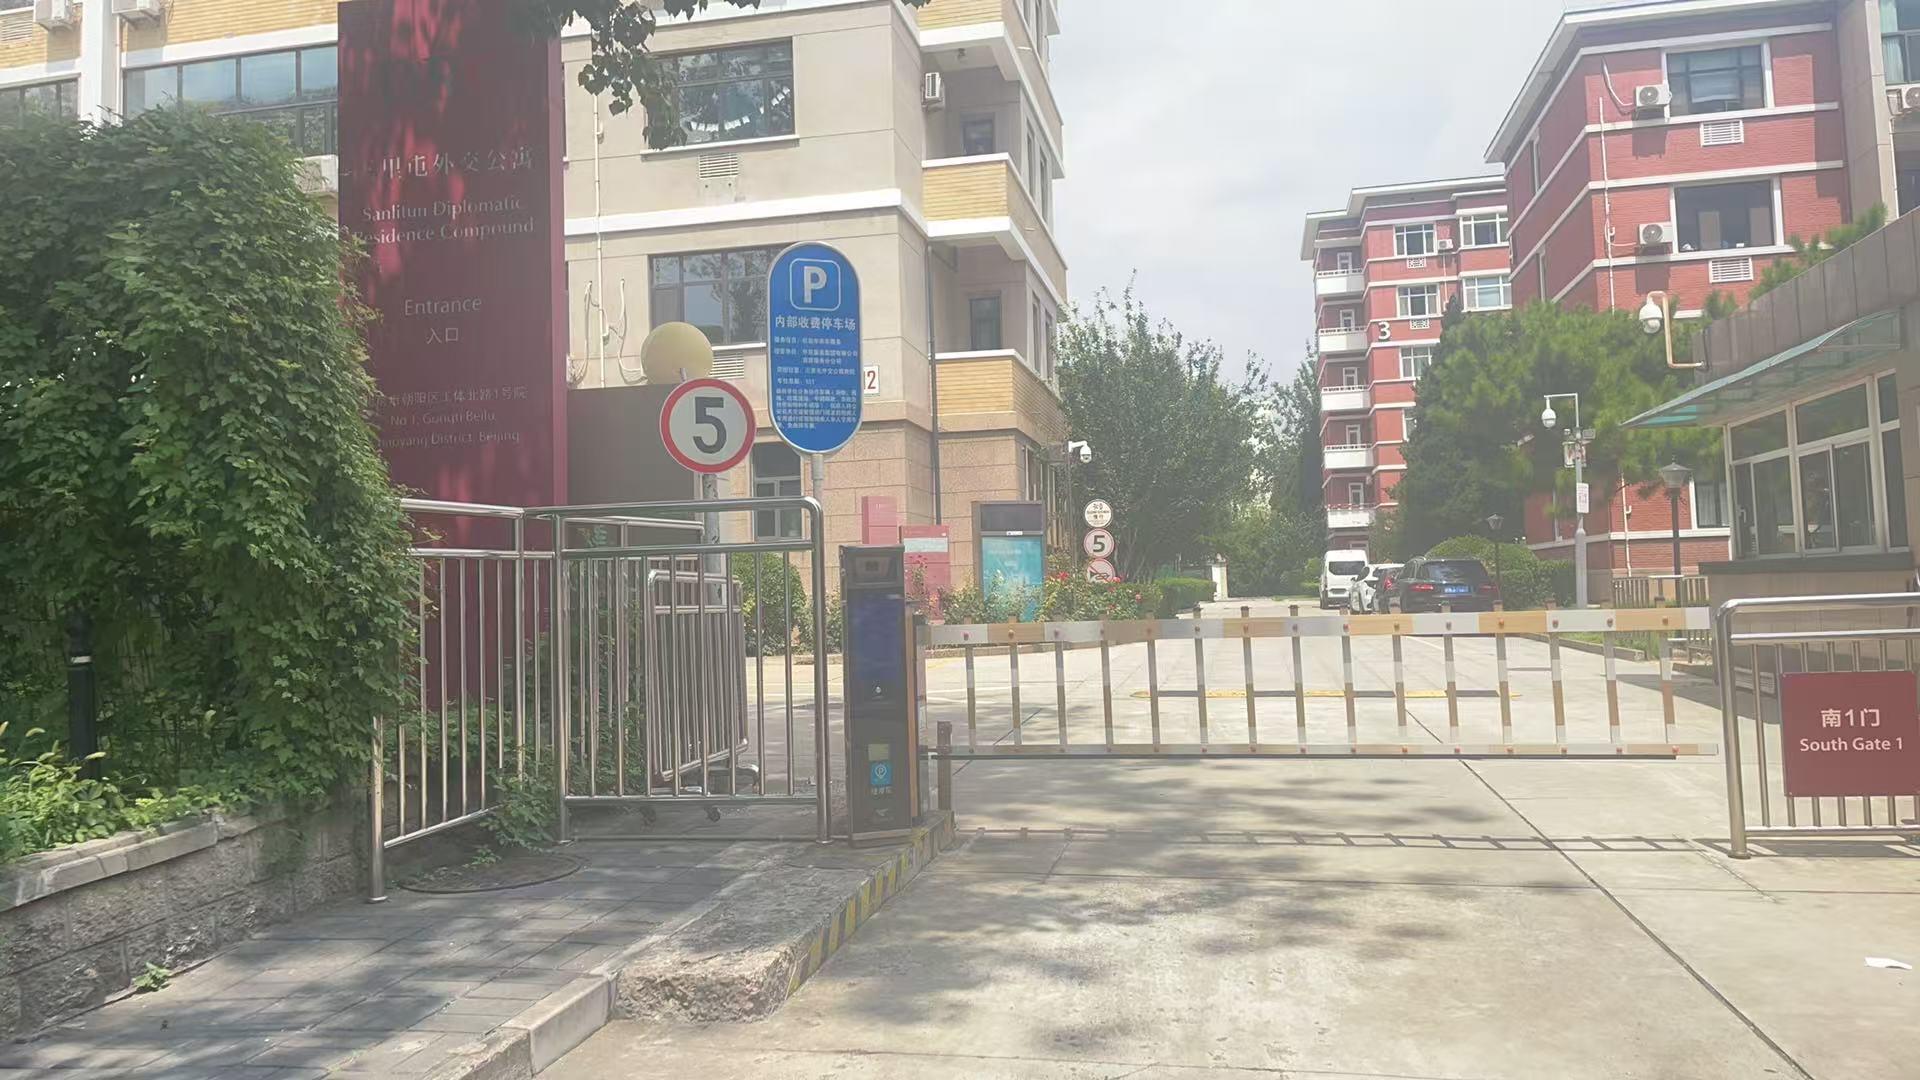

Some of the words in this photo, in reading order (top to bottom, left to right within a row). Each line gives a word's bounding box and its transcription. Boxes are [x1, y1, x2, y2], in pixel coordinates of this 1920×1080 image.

[360, 147, 533, 179] 里屯外交公寓
[362, 204, 428, 221] Sanlitun
[433, 196, 521, 220] Diplomatic
[440, 216, 534, 241] Compound
[803, 265, 828, 304] P
[404, 298, 482, 317] Entrance
[775, 315, 856, 332] 内部收费停车场
[1378, 321, 1391, 340] 3
[426, 327, 459, 344] 入口
[693, 396, 727, 454] 5
[1092, 534, 1106, 553] 5
[1820, 708, 1880, 728] 南1门
[1800, 737, 1848, 751] South
[1852, 737, 1891, 751] Gate
[1896, 737, 1903, 750] 1
